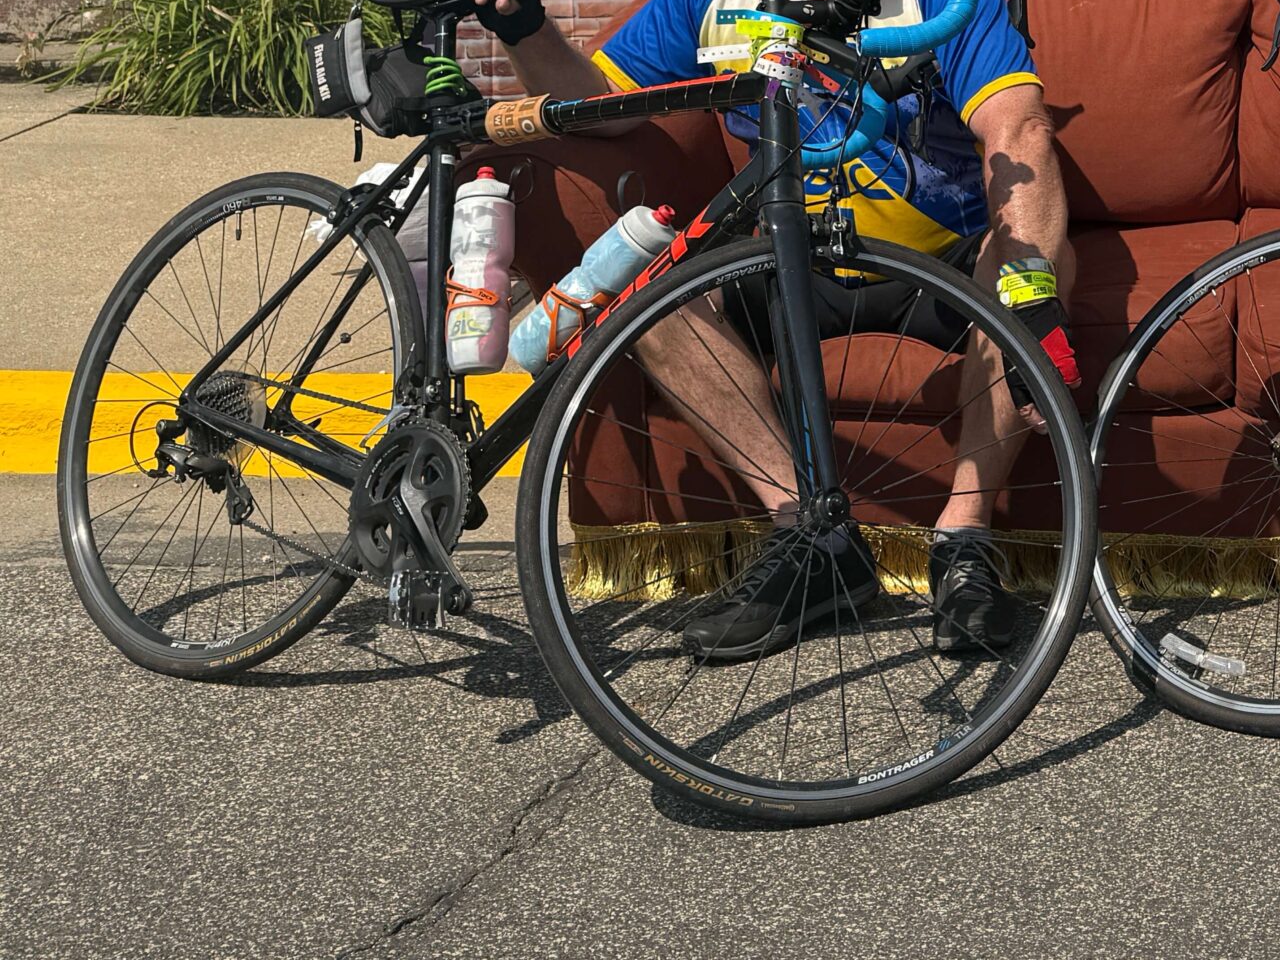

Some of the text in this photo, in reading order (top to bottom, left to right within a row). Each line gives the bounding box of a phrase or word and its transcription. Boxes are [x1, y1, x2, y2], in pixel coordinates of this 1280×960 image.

[313, 43, 332, 102] First Aid Kit
[953, 724, 972, 740] TLR
[643, 754, 754, 807] GATORSKIN
[857, 749, 934, 785] BONTRAGER
